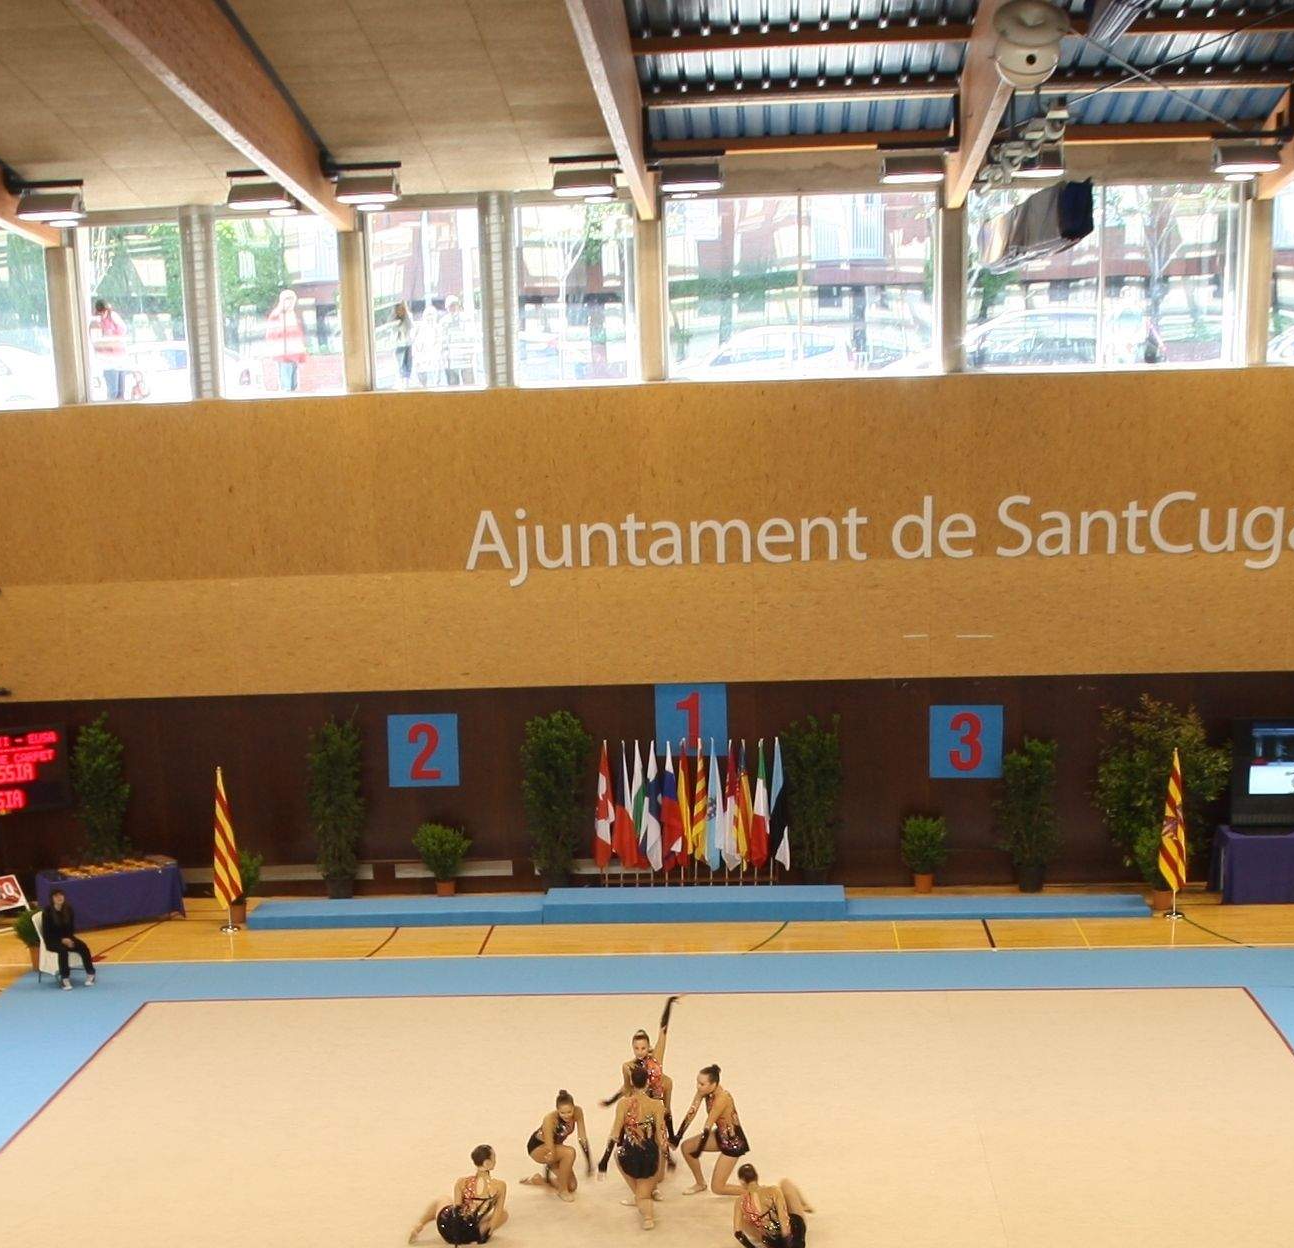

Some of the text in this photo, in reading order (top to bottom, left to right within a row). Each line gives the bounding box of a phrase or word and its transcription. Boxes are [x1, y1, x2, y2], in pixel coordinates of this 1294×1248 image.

[466, 506, 868, 586] Ajuntament
[893, 497, 975, 558] de
[677, 692, 701, 749] 1
[949, 712, 983, 771] 3
[13, 749, 55, 763] CARPET
[407, 723, 441, 779] 2
